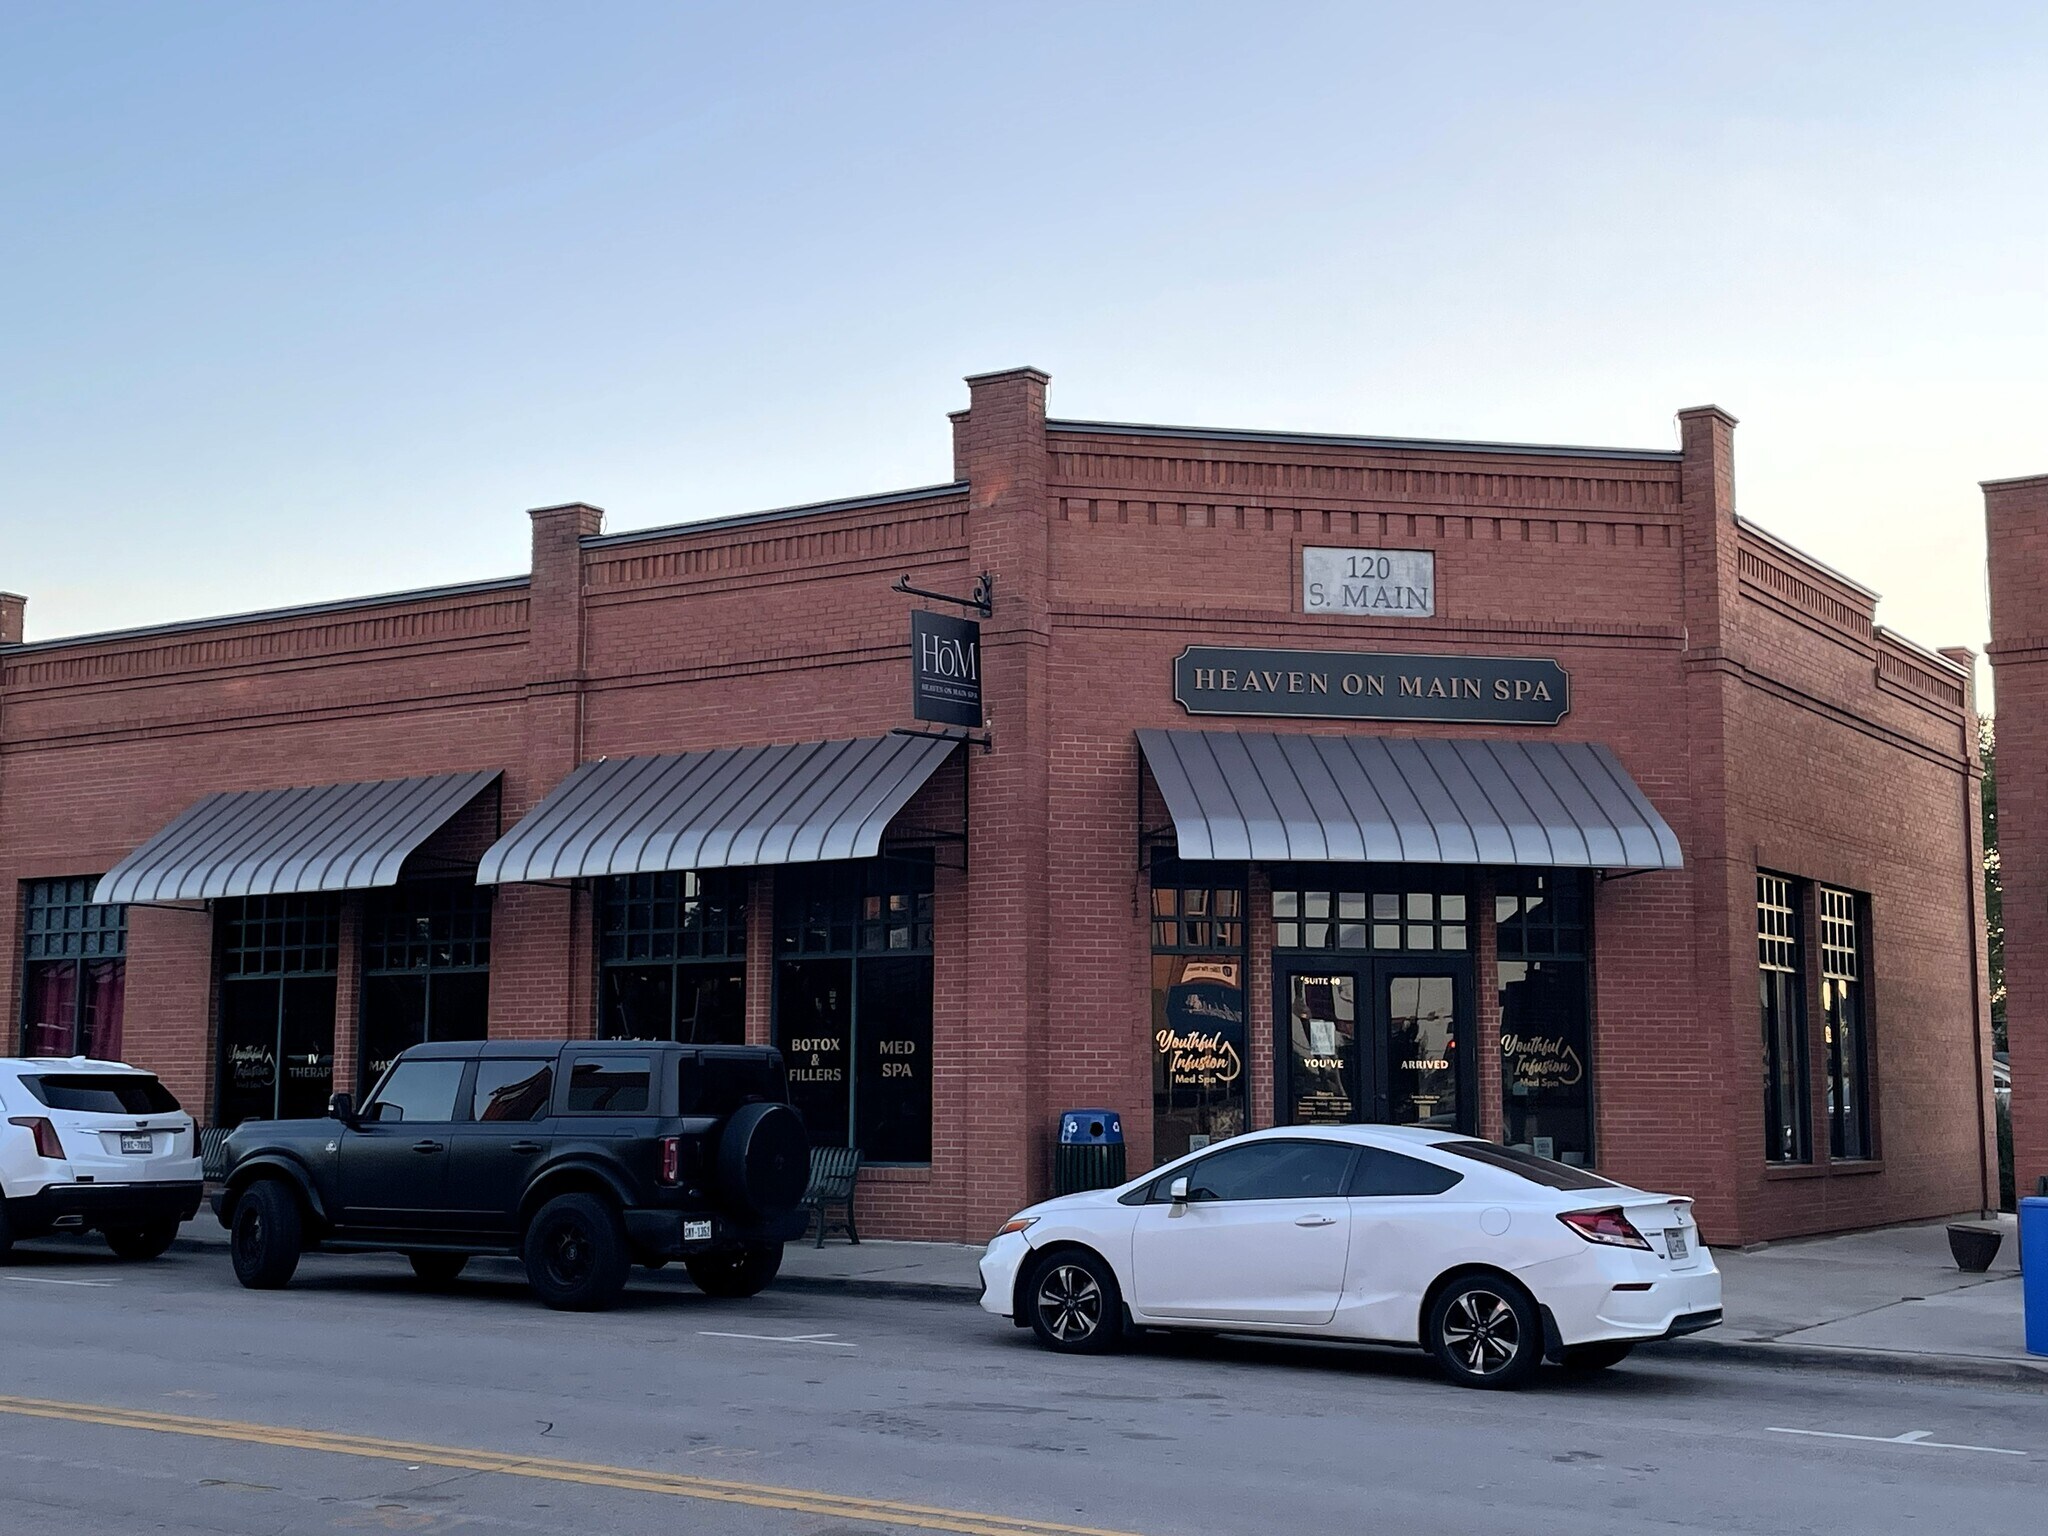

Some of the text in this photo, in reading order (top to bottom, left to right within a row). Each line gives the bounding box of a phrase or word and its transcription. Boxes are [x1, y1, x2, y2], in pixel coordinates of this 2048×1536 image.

[1347, 556, 1390, 580] 120
[1308, 583, 1429, 611] S. MAIN
[1194, 667, 1552, 702] HEAVEN ON MAIN SPA
[1304, 977, 1328, 986] SUITE
[791, 1038, 840, 1051] BOTOX
[879, 1041, 915, 1055] MED
[1156, 1029, 1221, 1053] Youthful
[1501, 1034, 1563, 1057] Youthful
[307, 1053, 319, 1065] IV
[810, 1054, 820, 1066] &
[1170, 1050, 1229, 1072] Infusion
[1304, 1059, 1344, 1069] YOU'VE
[1401, 1060, 1449, 1069] ARRIVED
[1513, 1055, 1571, 1076] Infusion
[289, 1067, 334, 1078] THERAP
[789, 1068, 841, 1081] FILLERS
[882, 1063, 912, 1077] SPA
[1175, 1074, 1217, 1088] Med Spa
[1520, 1078, 1559, 1089] Med Spa
